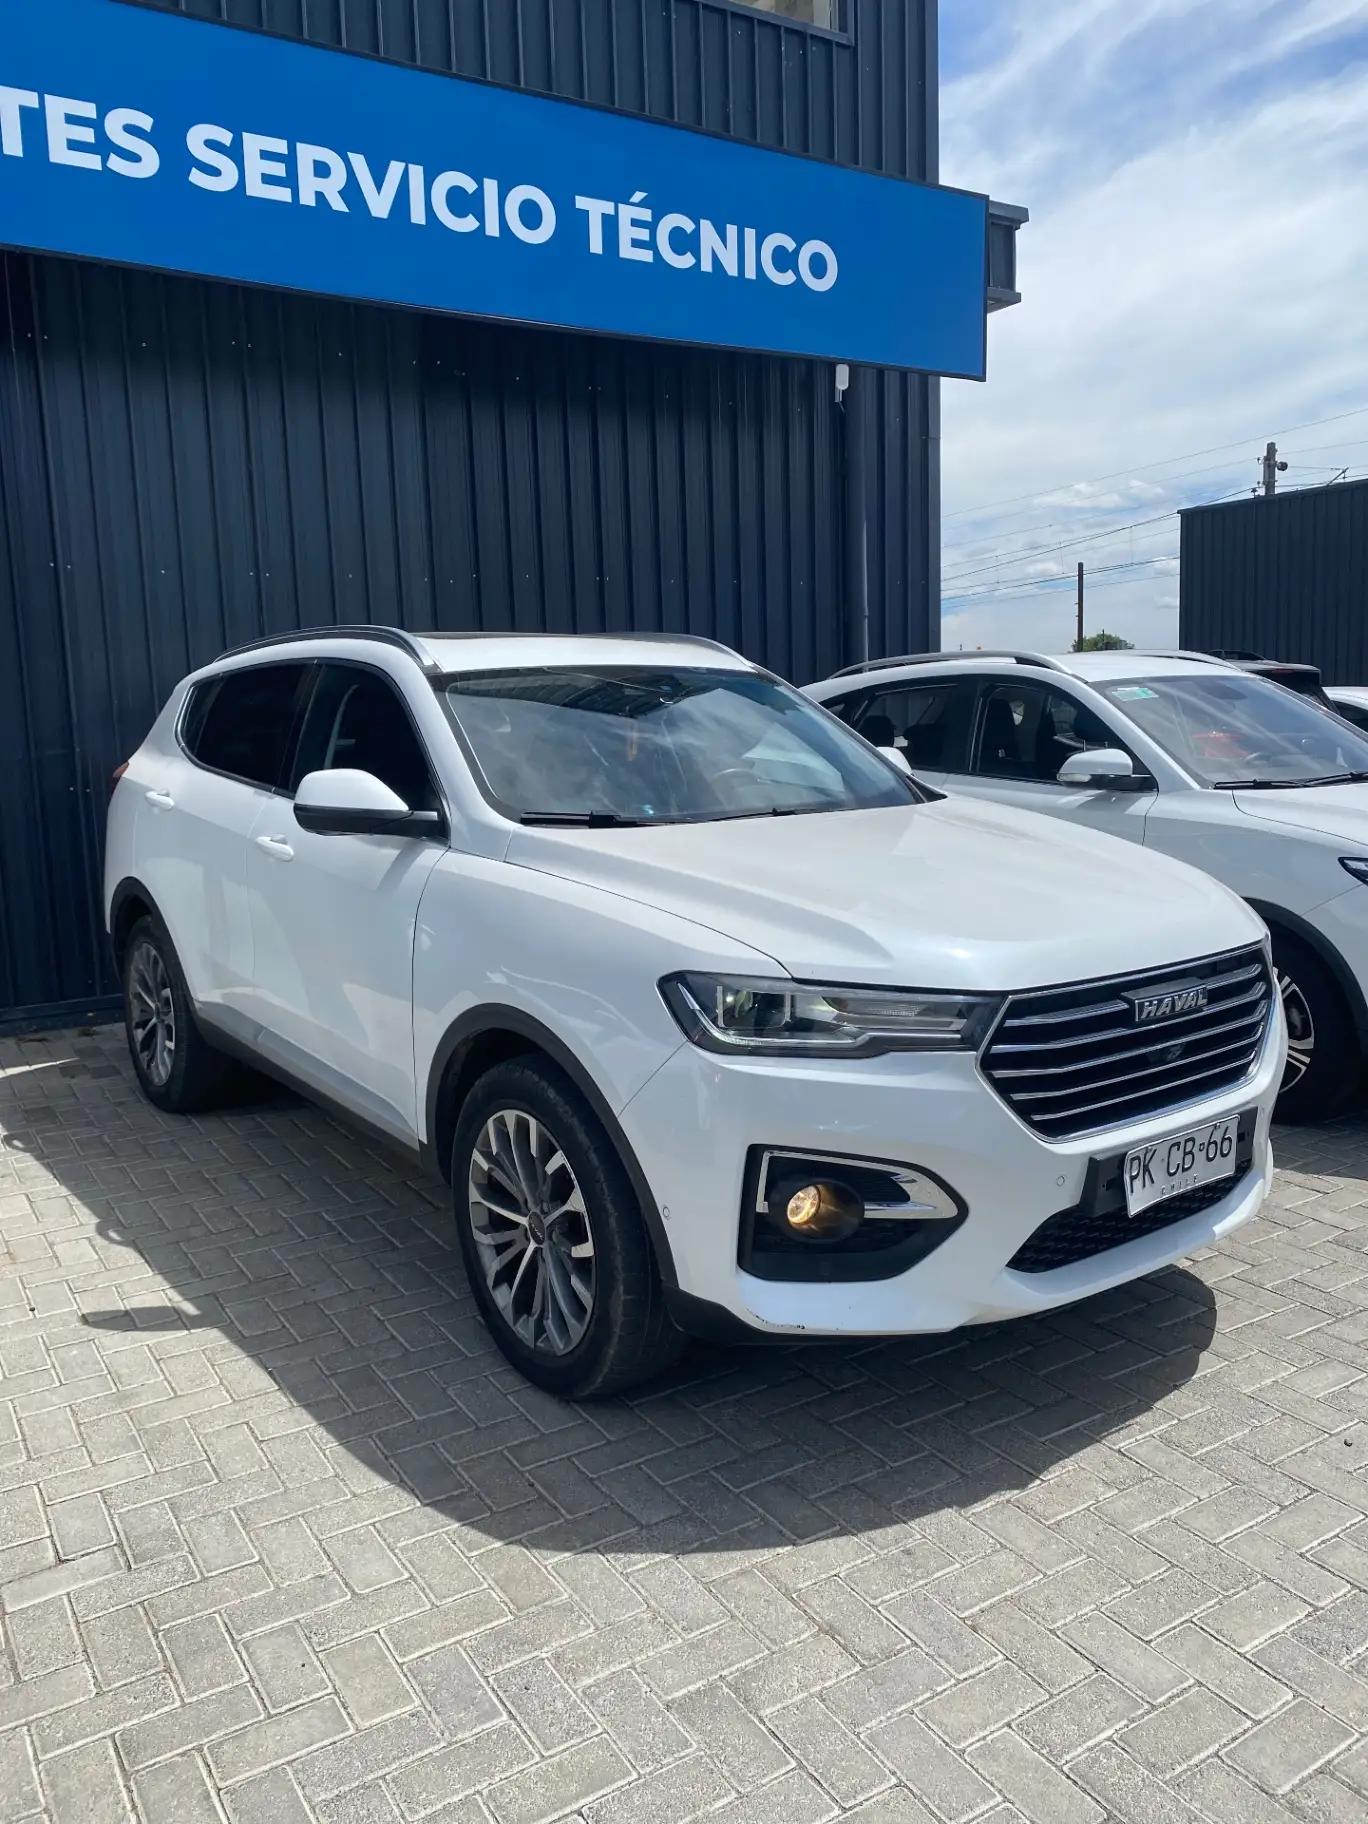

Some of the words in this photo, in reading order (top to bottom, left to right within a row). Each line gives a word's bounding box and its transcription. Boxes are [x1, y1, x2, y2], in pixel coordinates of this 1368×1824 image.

[0, 86, 160, 178] TES
[187, 124, 556, 244] SERVICIO
[576, 191, 838, 291] TÉCNICO
[1141, 988, 1208, 1019] HAVAL
